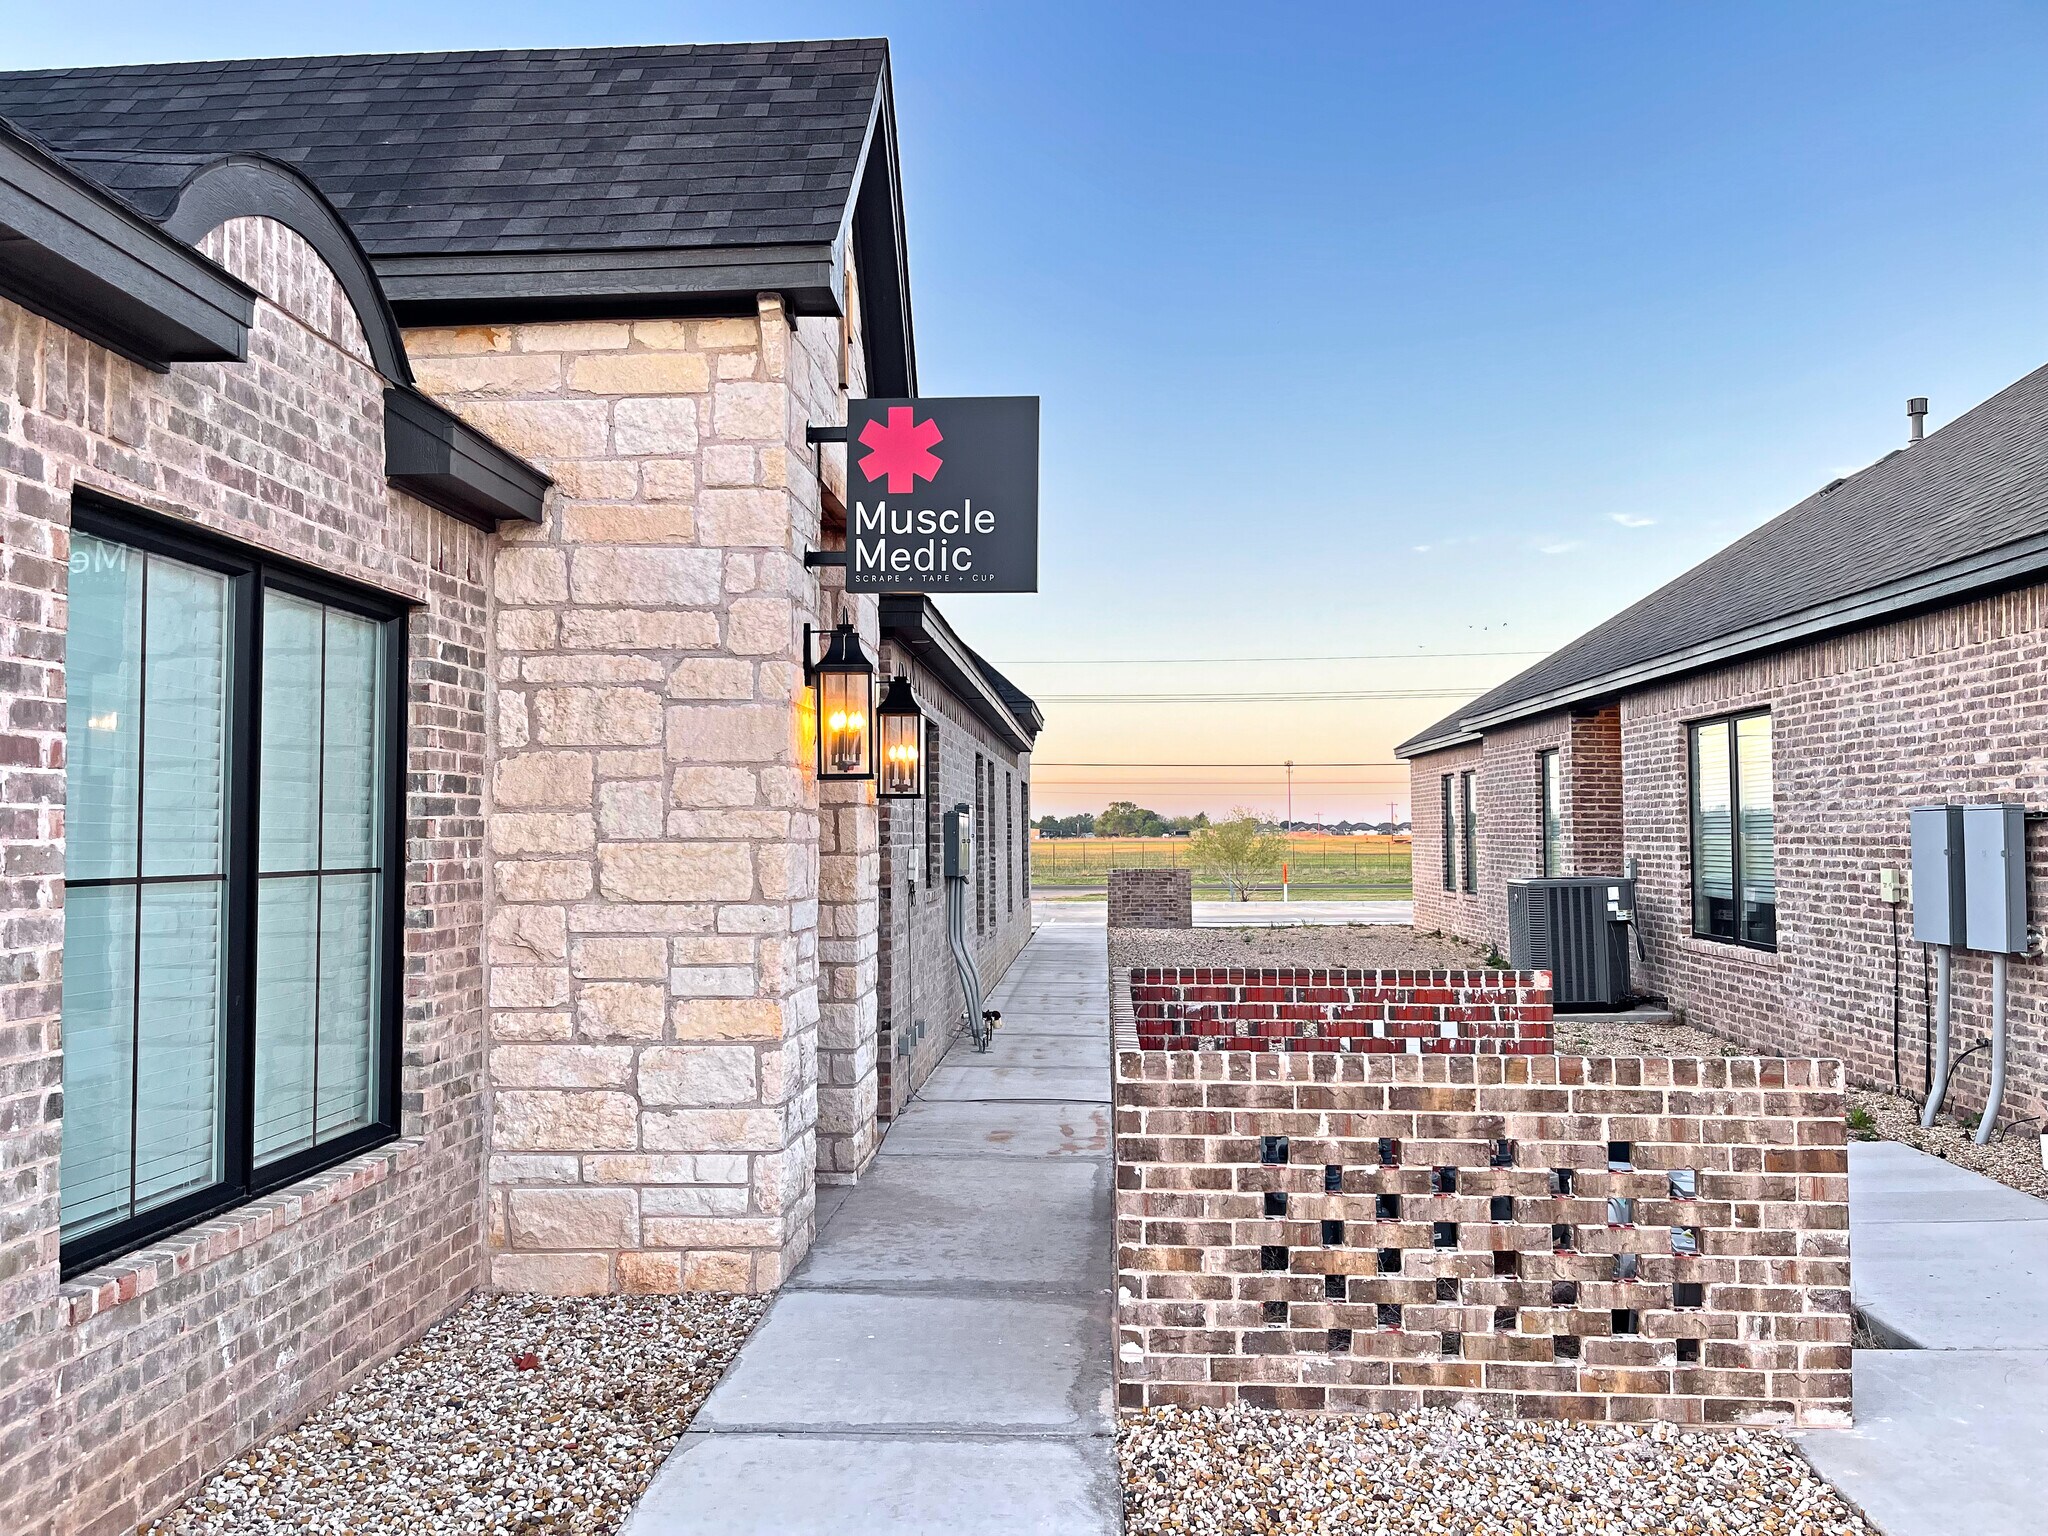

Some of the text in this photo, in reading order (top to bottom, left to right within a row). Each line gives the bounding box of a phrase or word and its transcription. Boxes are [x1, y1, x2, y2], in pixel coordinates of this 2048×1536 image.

[855, 499, 995, 535] Muscle
[855, 538, 972, 572] Medic
[855, 574, 900, 583] SCRAPE
[921, 574, 950, 582] TAPE
[972, 573, 995, 582] CUP
